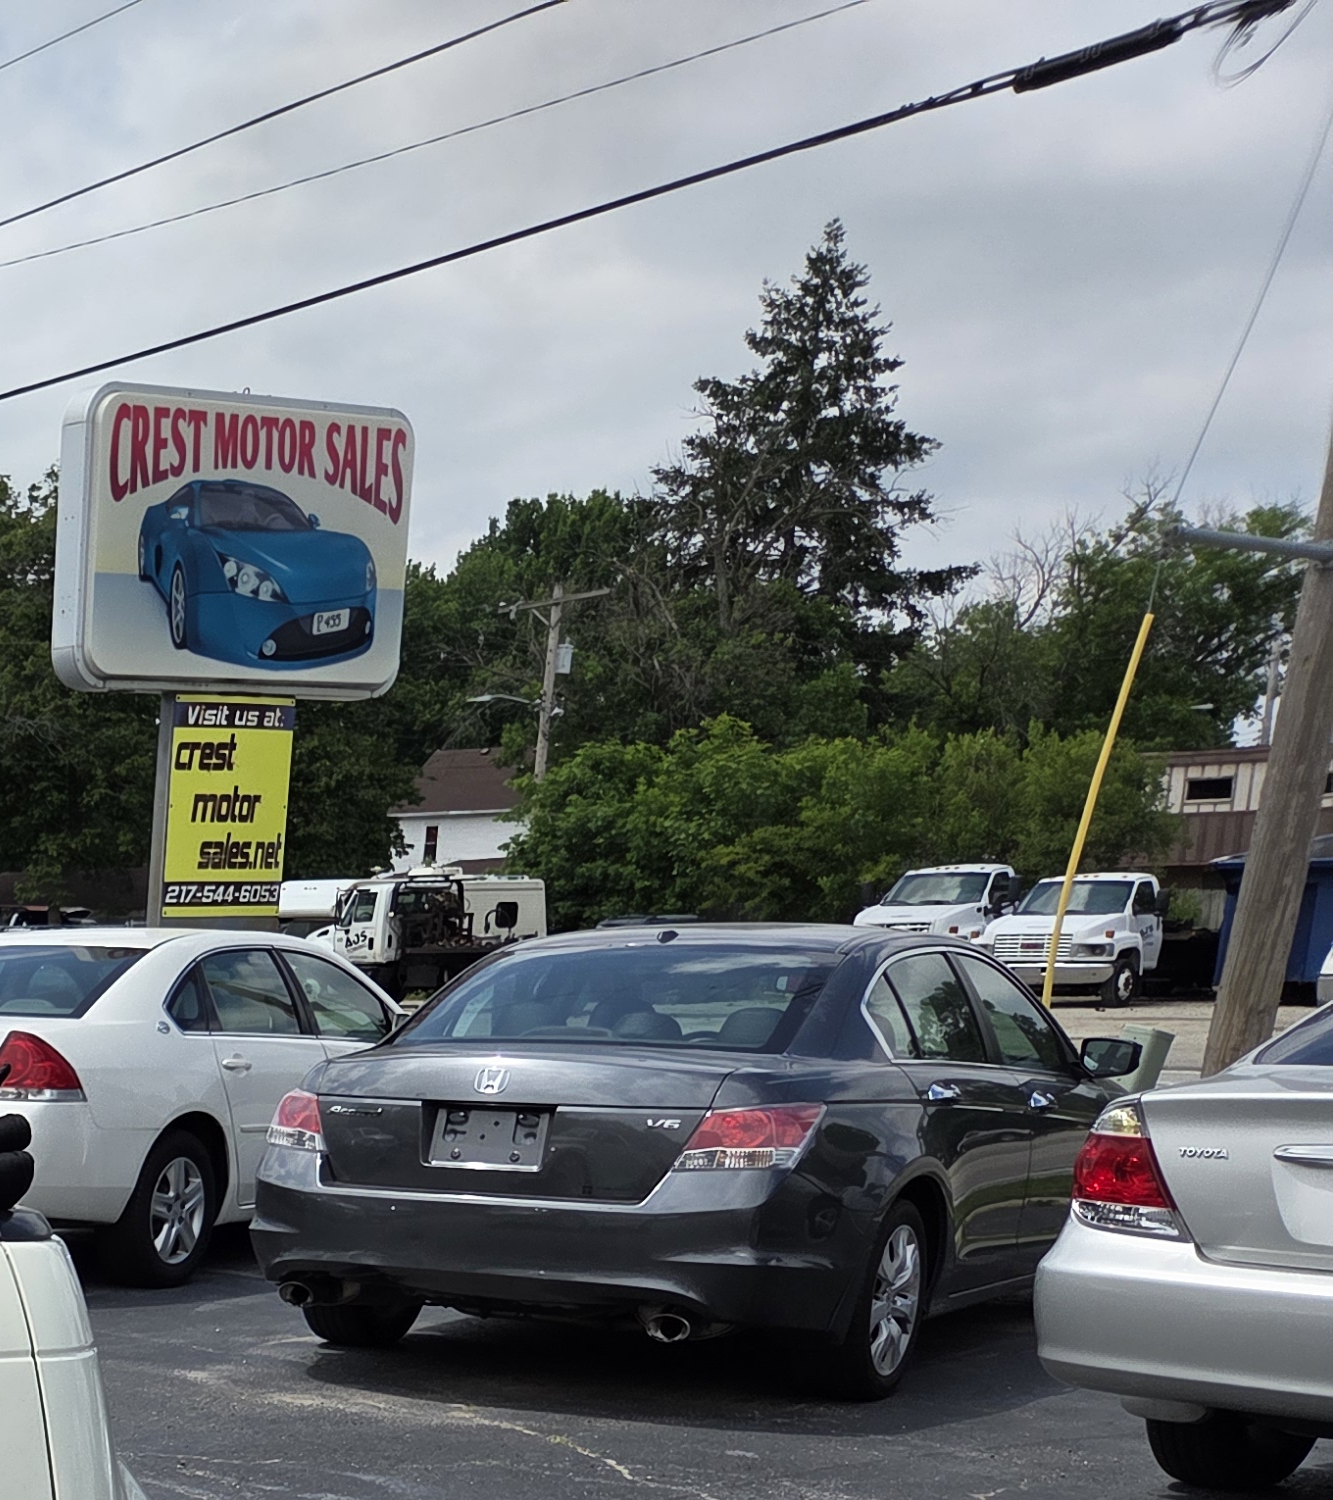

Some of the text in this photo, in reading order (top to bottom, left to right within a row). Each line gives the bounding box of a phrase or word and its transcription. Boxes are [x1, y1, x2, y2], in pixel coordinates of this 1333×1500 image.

[109, 403, 407, 526] CREST MOTOR SALES
[188, 705, 229, 725] Visit
[234, 709, 259, 726] us
[174, 733, 237, 771] crest
[190, 785, 262, 823] motor
[197, 832, 282, 870] sales.net
[165, 884, 280, 904] 217-544-6053
[646, 1118, 682, 1129] V6
[1178, 1146, 1230, 1160] TOYOTA
